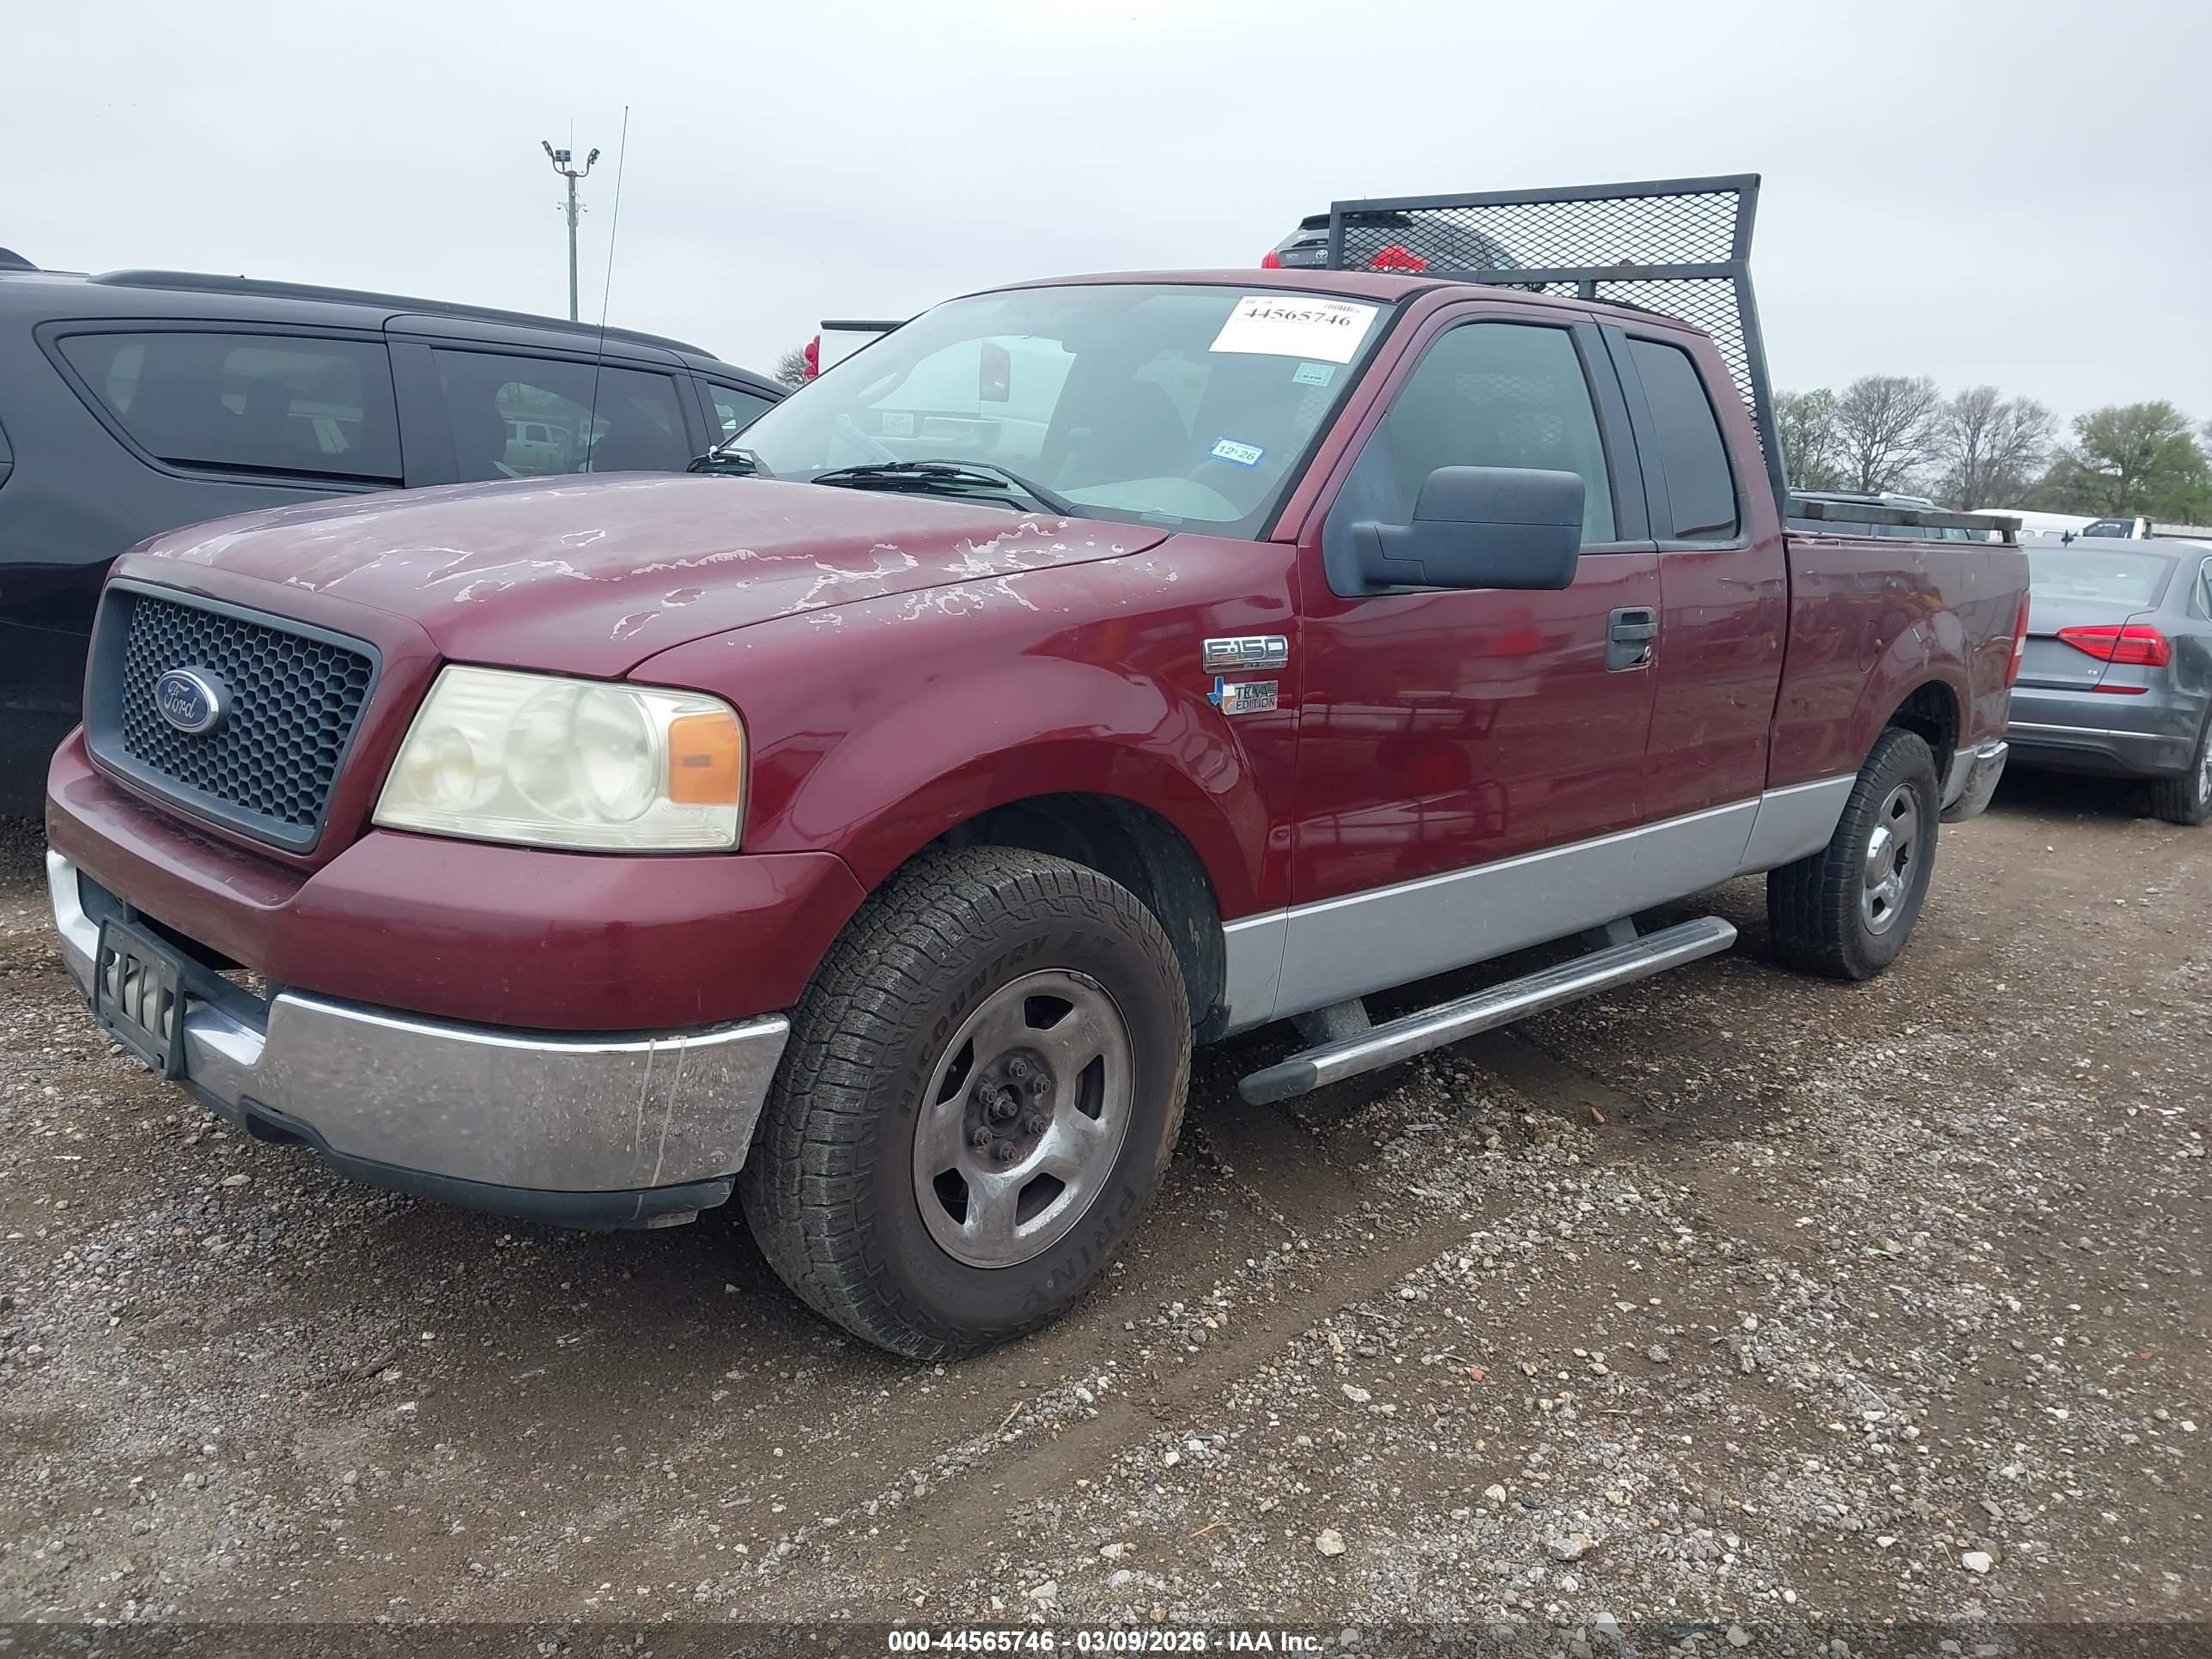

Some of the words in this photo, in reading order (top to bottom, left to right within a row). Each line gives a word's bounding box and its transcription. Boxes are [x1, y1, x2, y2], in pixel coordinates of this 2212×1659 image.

[1244, 308, 1353, 326] 44565746
[1206, 638, 1286, 662] F-150
[164, 680, 198, 719] Ford
[1236, 684, 1277, 700] TEXAS
[1236, 697, 1276, 710] EDITION
